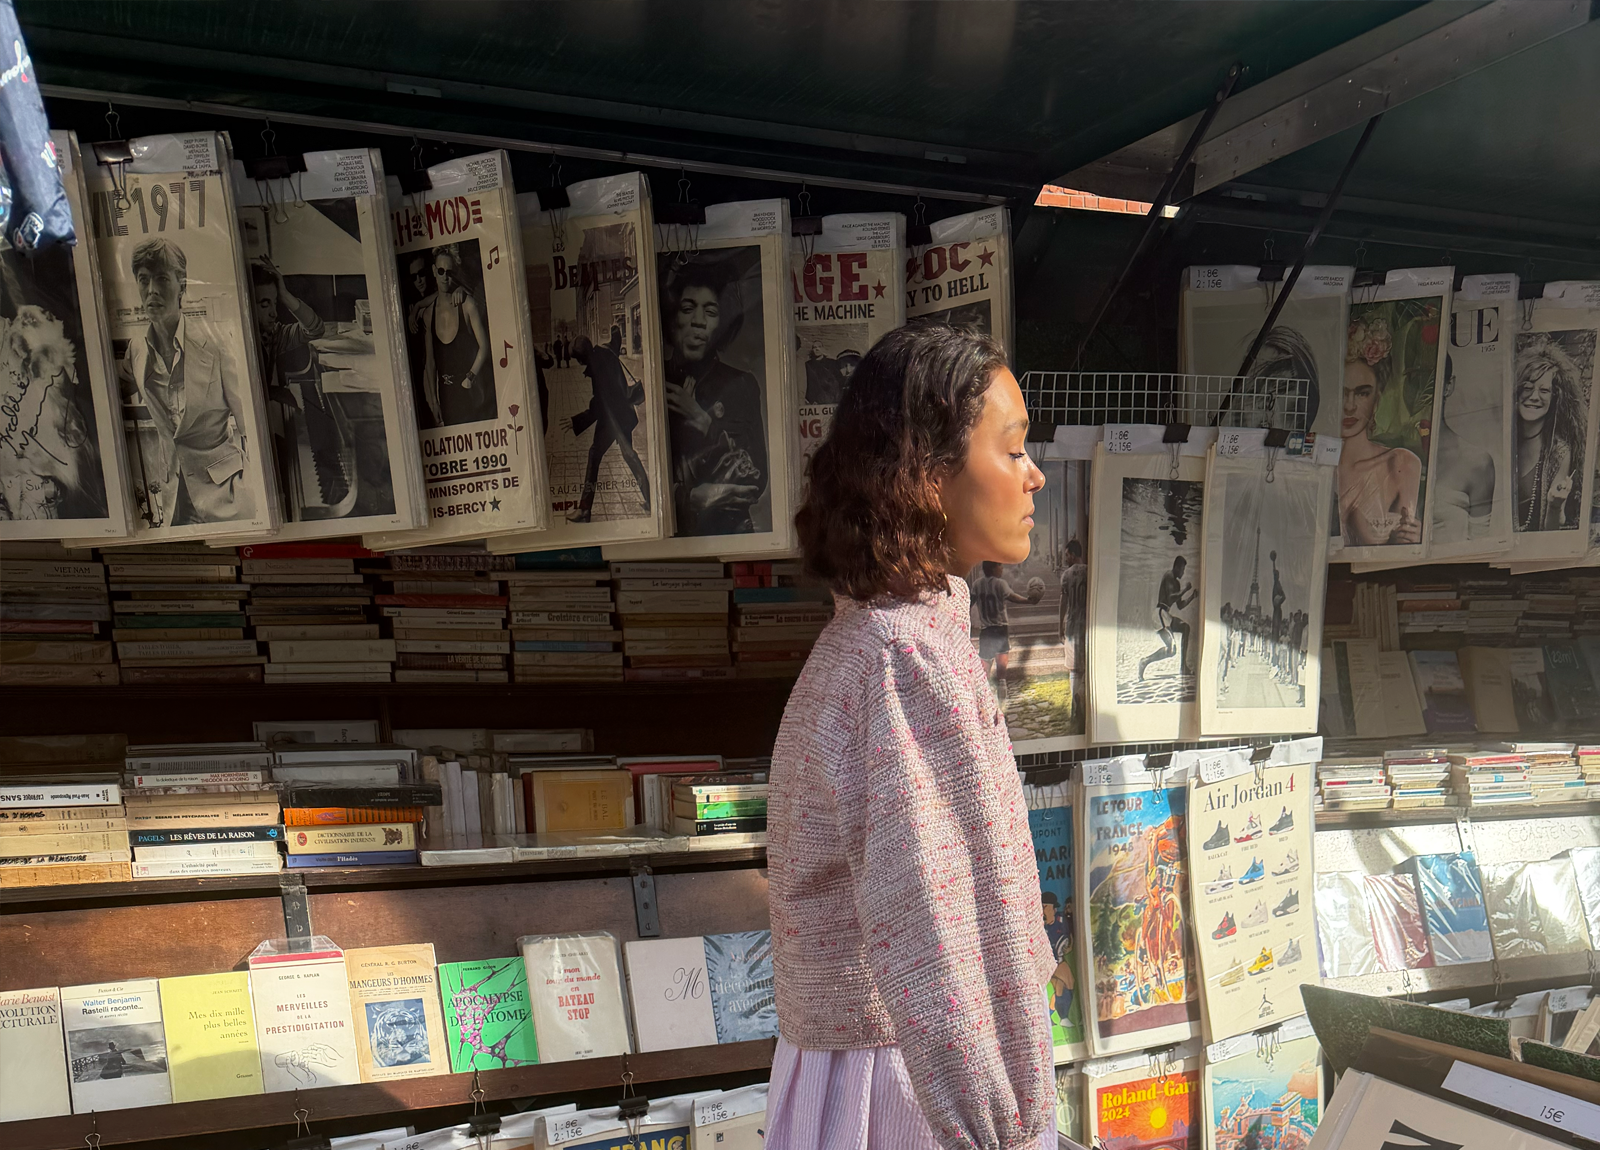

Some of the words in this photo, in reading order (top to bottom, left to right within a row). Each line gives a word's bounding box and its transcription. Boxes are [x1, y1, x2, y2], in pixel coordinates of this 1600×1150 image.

[130, 179, 206, 234] 1977
[425, 196, 483, 240] MODE
[552, 254, 639, 291] BEATLES
[921, 283, 943, 304] TO
[947, 272, 990, 299] HELL
[814, 303, 876, 321] MACHINE
[475, 428, 509, 450] TOUR
[473, 453, 508, 471] 1990
[428, 478, 500, 499] MNISPORTS
[503, 476, 520, 490] DE
[557, 485, 570, 494] AU
[433, 500, 488, 519] IS-BERCY
[54, 566, 73, 574] VIET
[0, 794, 22, 802] SANS
[1203, 787, 1230, 814] Air
[1231, 777, 1283, 810] Jordan
[1285, 771, 1297, 793] 4
[1109, 797, 1143, 812] TOUR
[138, 833, 165, 843] PAGELS
[170, 832, 183, 841] LES
[184, 830, 207, 841] RÊVES
[207, 831, 217, 839] DE
[217, 830, 228, 838] LA
[229, 828, 256, 838] RAISON
[317, 832, 357, 841] DICTIONNAIRE
[1096, 822, 1144, 840] FRANCE
[1508, 824, 1581, 844] COASTERS
[562, 967, 581, 975] mon
[564, 976, 575, 984] du
[577, 973, 601, 983] monde
[349, 978, 392, 989] MANGEURS
[393, 974, 434, 987] D'HOMMES
[21, 992, 57, 1005] Benoist
[82, 998, 108, 1007] Walter
[107, 995, 142, 1006] Benjamin
[447, 990, 524, 1009] APOCALYPSE
[557, 992, 596, 1008] BATEAU
[82, 1003, 110, 1016] Rastelli
[188, 1011, 208, 1020] Mes
[209, 1009, 224, 1018] dix
[225, 1007, 246, 1017] mille
[276, 1000, 330, 1013] MERVEILLES
[566, 1007, 591, 1021] STOP
[203, 1020, 221, 1032] plus
[223, 1016, 248, 1028] belles
[265, 1020, 345, 1035] PRESTIDIGITATION
[449, 1013, 467, 1028] DE
[220, 1031, 249, 1040] années
[1101, 1107, 1131, 1123] 2024
[1540, 1104, 1566, 1124] 15€
